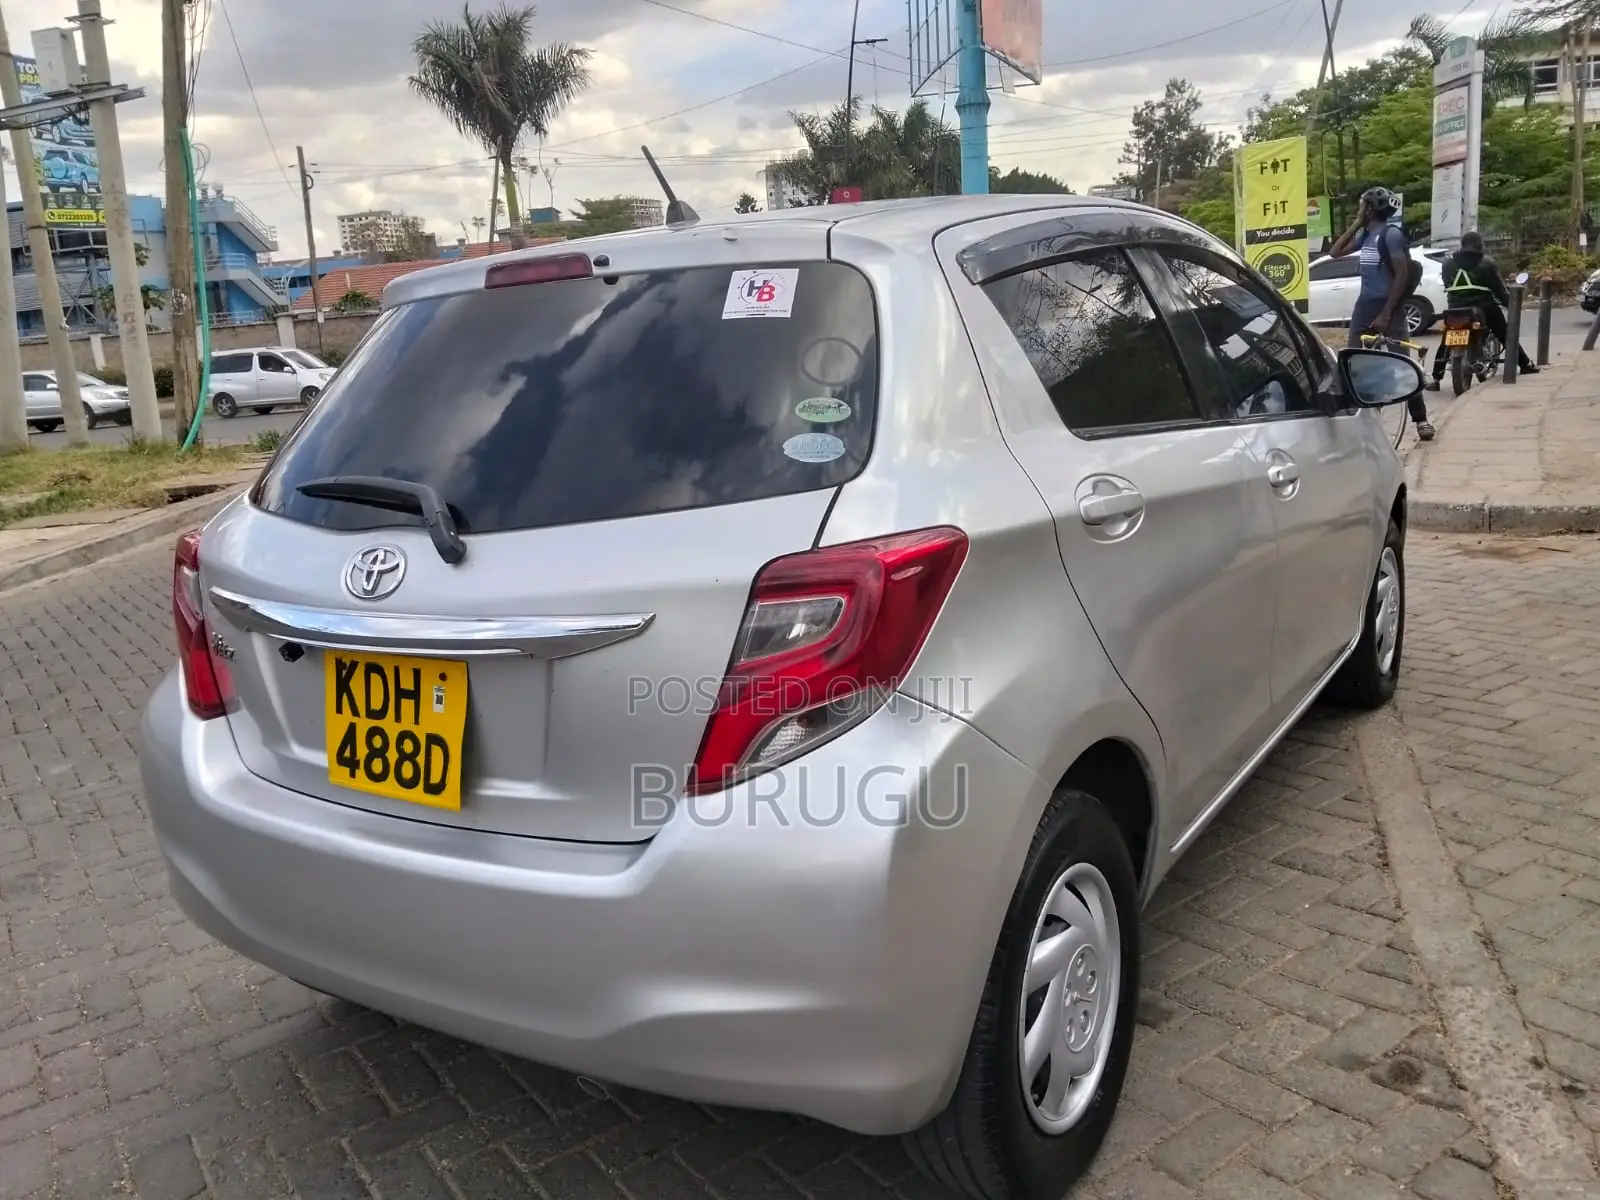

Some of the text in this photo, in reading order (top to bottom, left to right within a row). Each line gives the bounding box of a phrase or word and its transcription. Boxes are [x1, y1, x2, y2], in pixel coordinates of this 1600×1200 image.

[1271, 227, 1295, 236] decide
[1264, 264, 1291, 272] Fitness
[746, 279, 776, 303] HB
[334, 657, 422, 726] KDH
[336, 721, 450, 796] 488D
